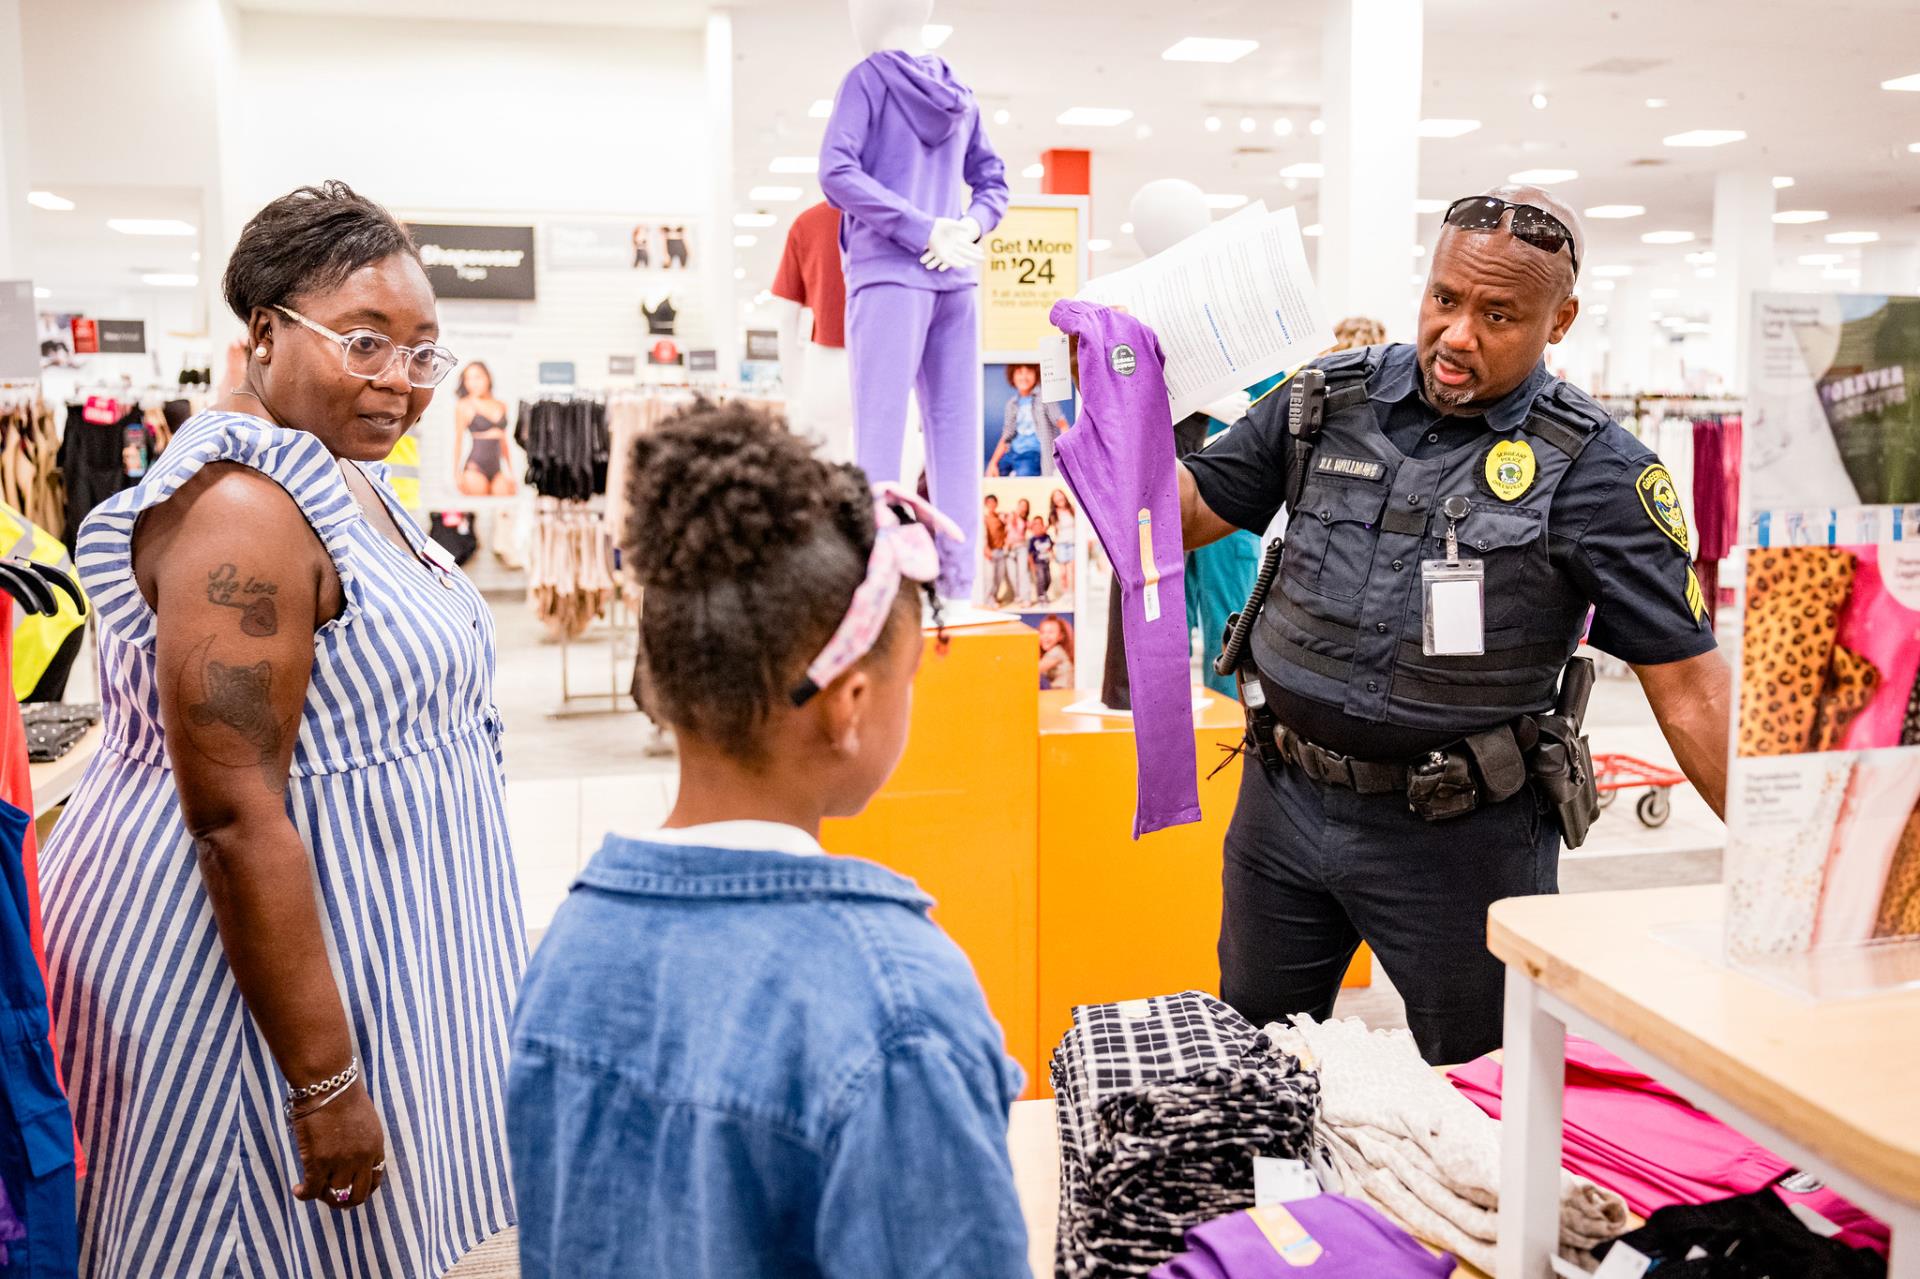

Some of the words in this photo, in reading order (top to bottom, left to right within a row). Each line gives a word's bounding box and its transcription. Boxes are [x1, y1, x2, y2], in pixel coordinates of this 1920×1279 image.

[991, 238, 1021, 253] Get
[1028, 239, 1073, 253] More
[991, 258, 1006, 271] in
